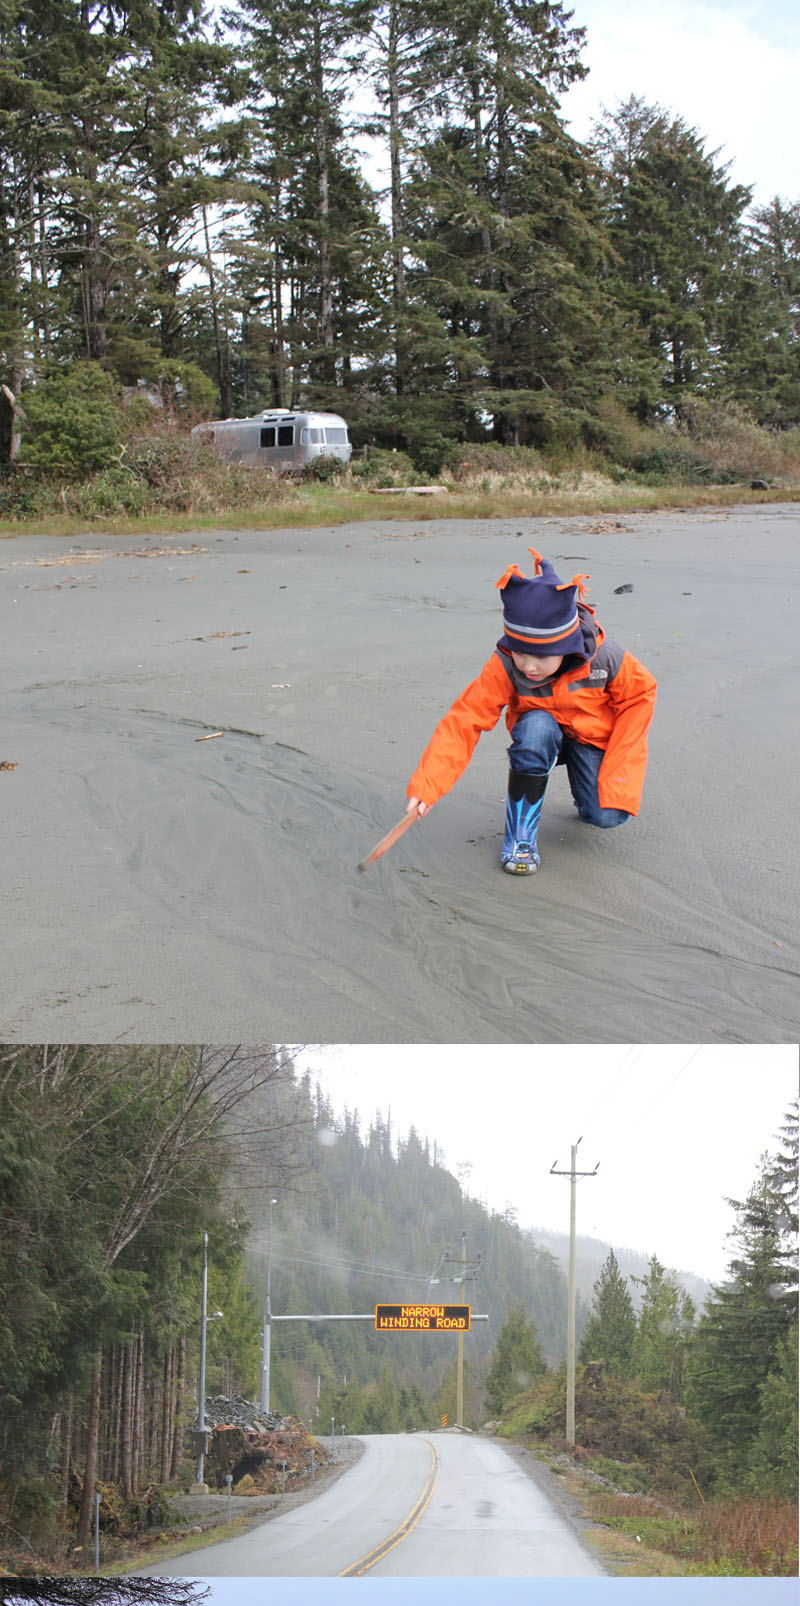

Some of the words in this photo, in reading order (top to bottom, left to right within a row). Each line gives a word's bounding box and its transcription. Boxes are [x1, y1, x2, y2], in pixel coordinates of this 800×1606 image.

[401, 1307, 445, 1317] NARROW
[380, 1317, 430, 1328] WINDING
[436, 1318, 466, 1328] ROAD
